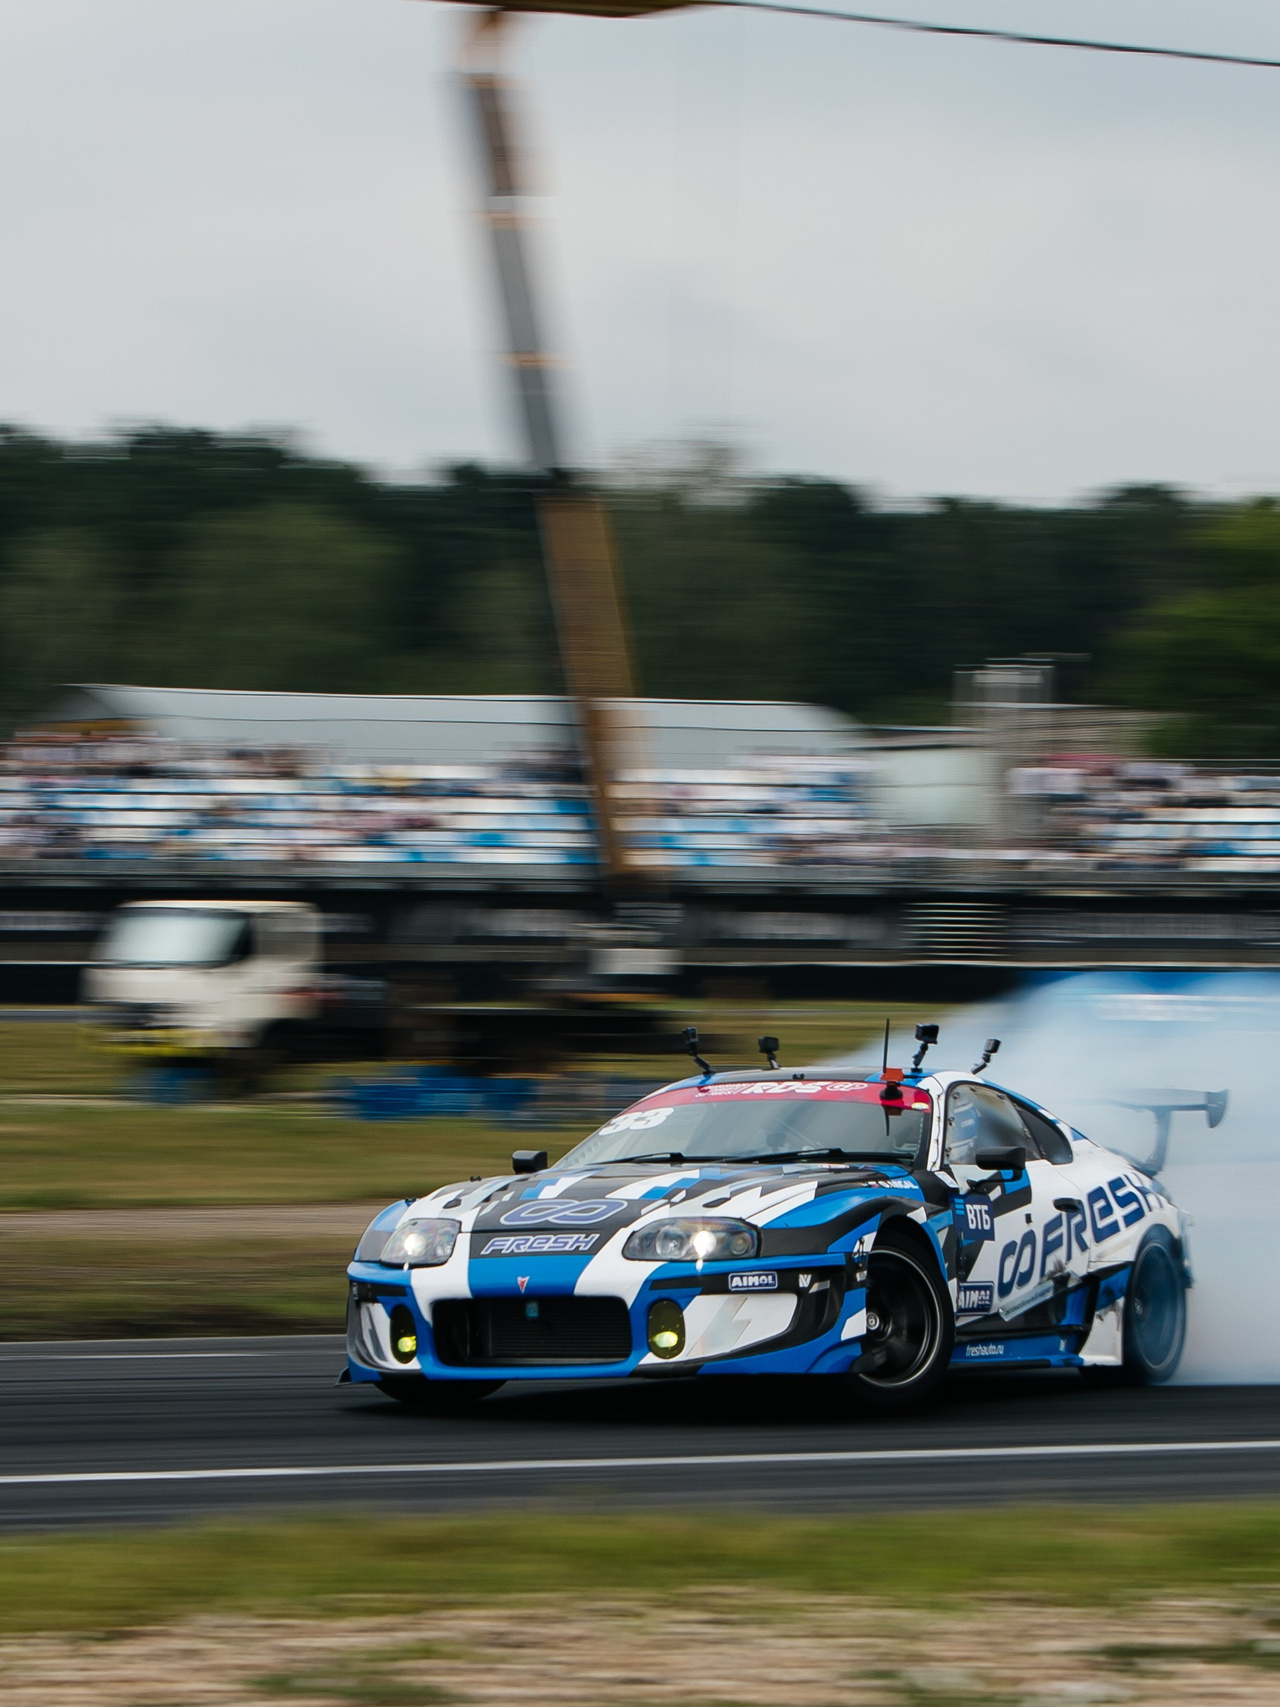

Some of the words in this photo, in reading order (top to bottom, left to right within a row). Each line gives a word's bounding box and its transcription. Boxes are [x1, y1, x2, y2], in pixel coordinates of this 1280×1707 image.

[742, 1081, 831, 1094] RDS
[831, 1083, 866, 1092] GP
[598, 1107, 675, 1136] 33
[966, 1203, 991, 1231] ВТБ
[480, 1233, 600, 1256] FRESH
[731, 1274, 776, 1288] AIMOL
[966, 1343, 1004, 1357] freshauto.ru
